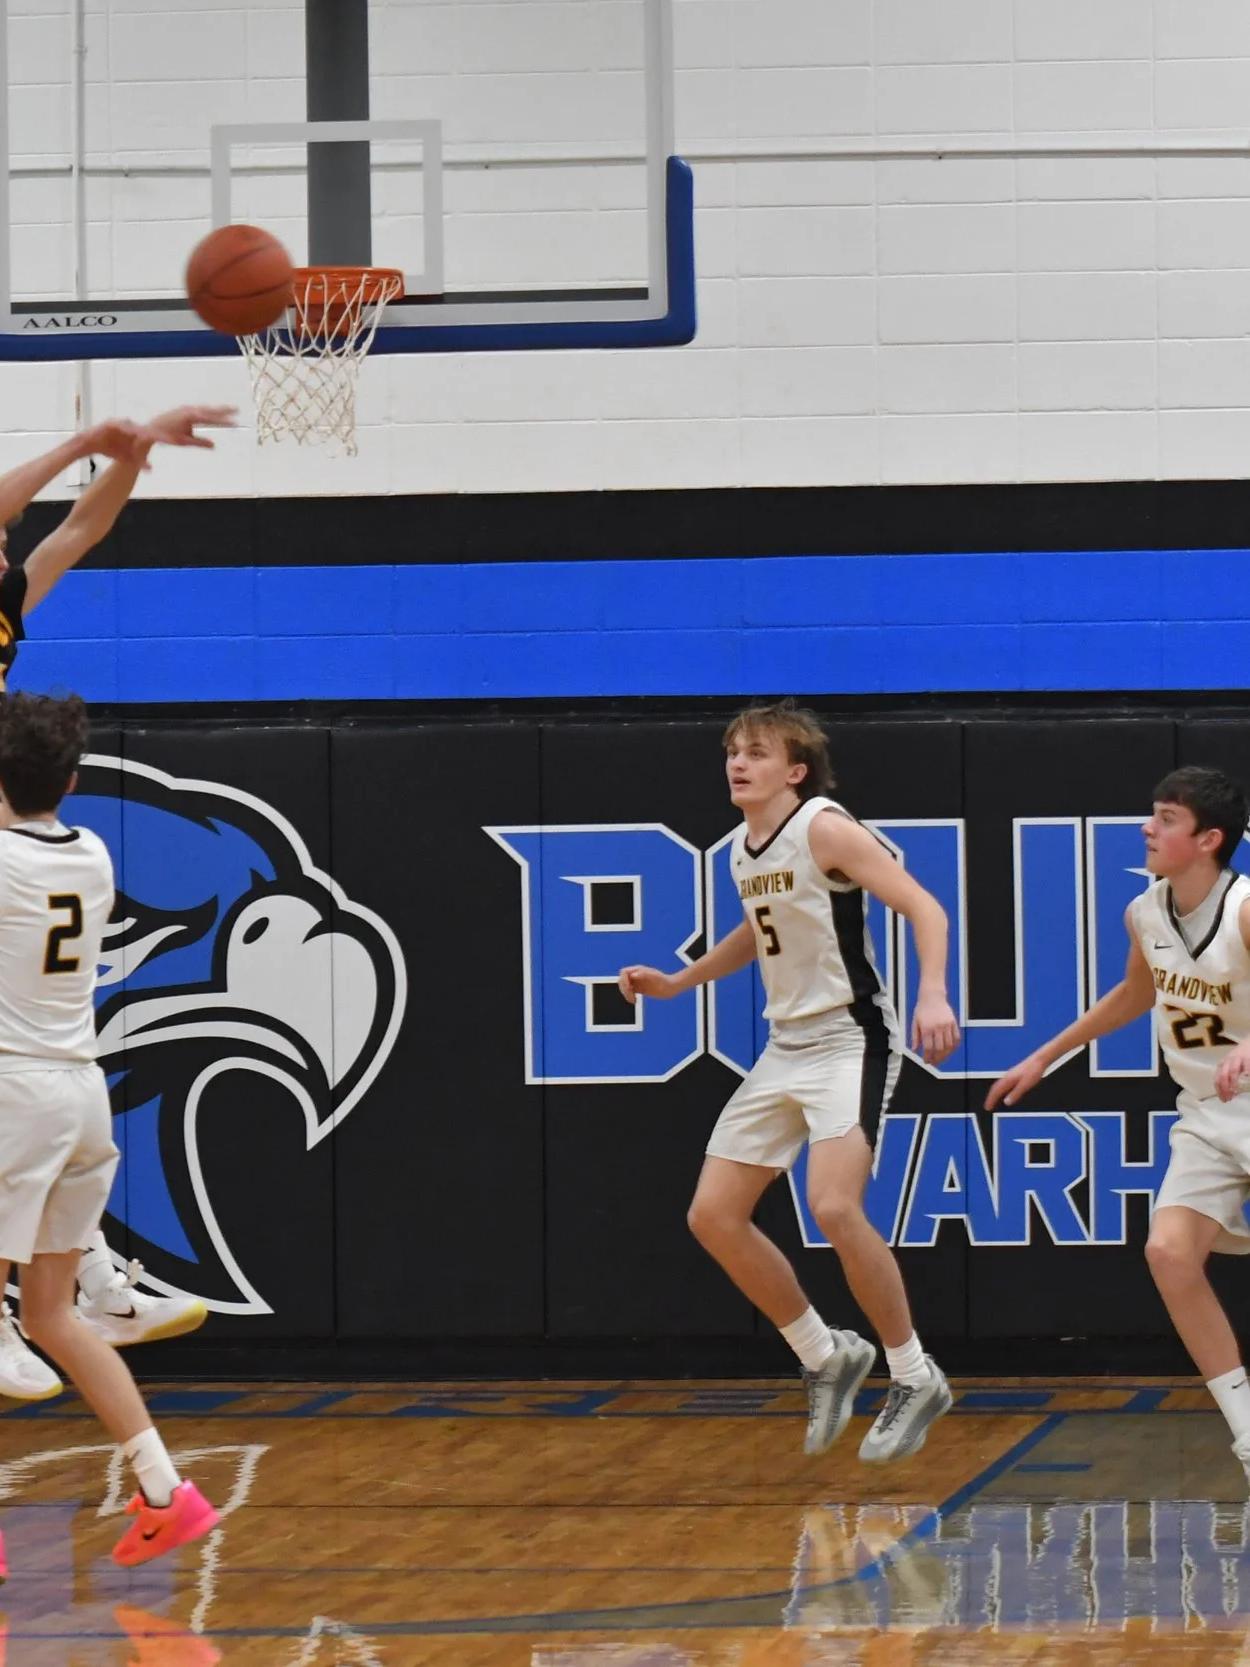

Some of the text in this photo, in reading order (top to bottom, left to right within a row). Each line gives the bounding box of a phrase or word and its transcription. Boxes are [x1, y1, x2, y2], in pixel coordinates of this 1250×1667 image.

[23, 315, 117, 329] AALCO
[42, 892, 83, 975] 2
[754, 905, 781, 956] 5
[1162, 1003, 1239, 1051] 22
